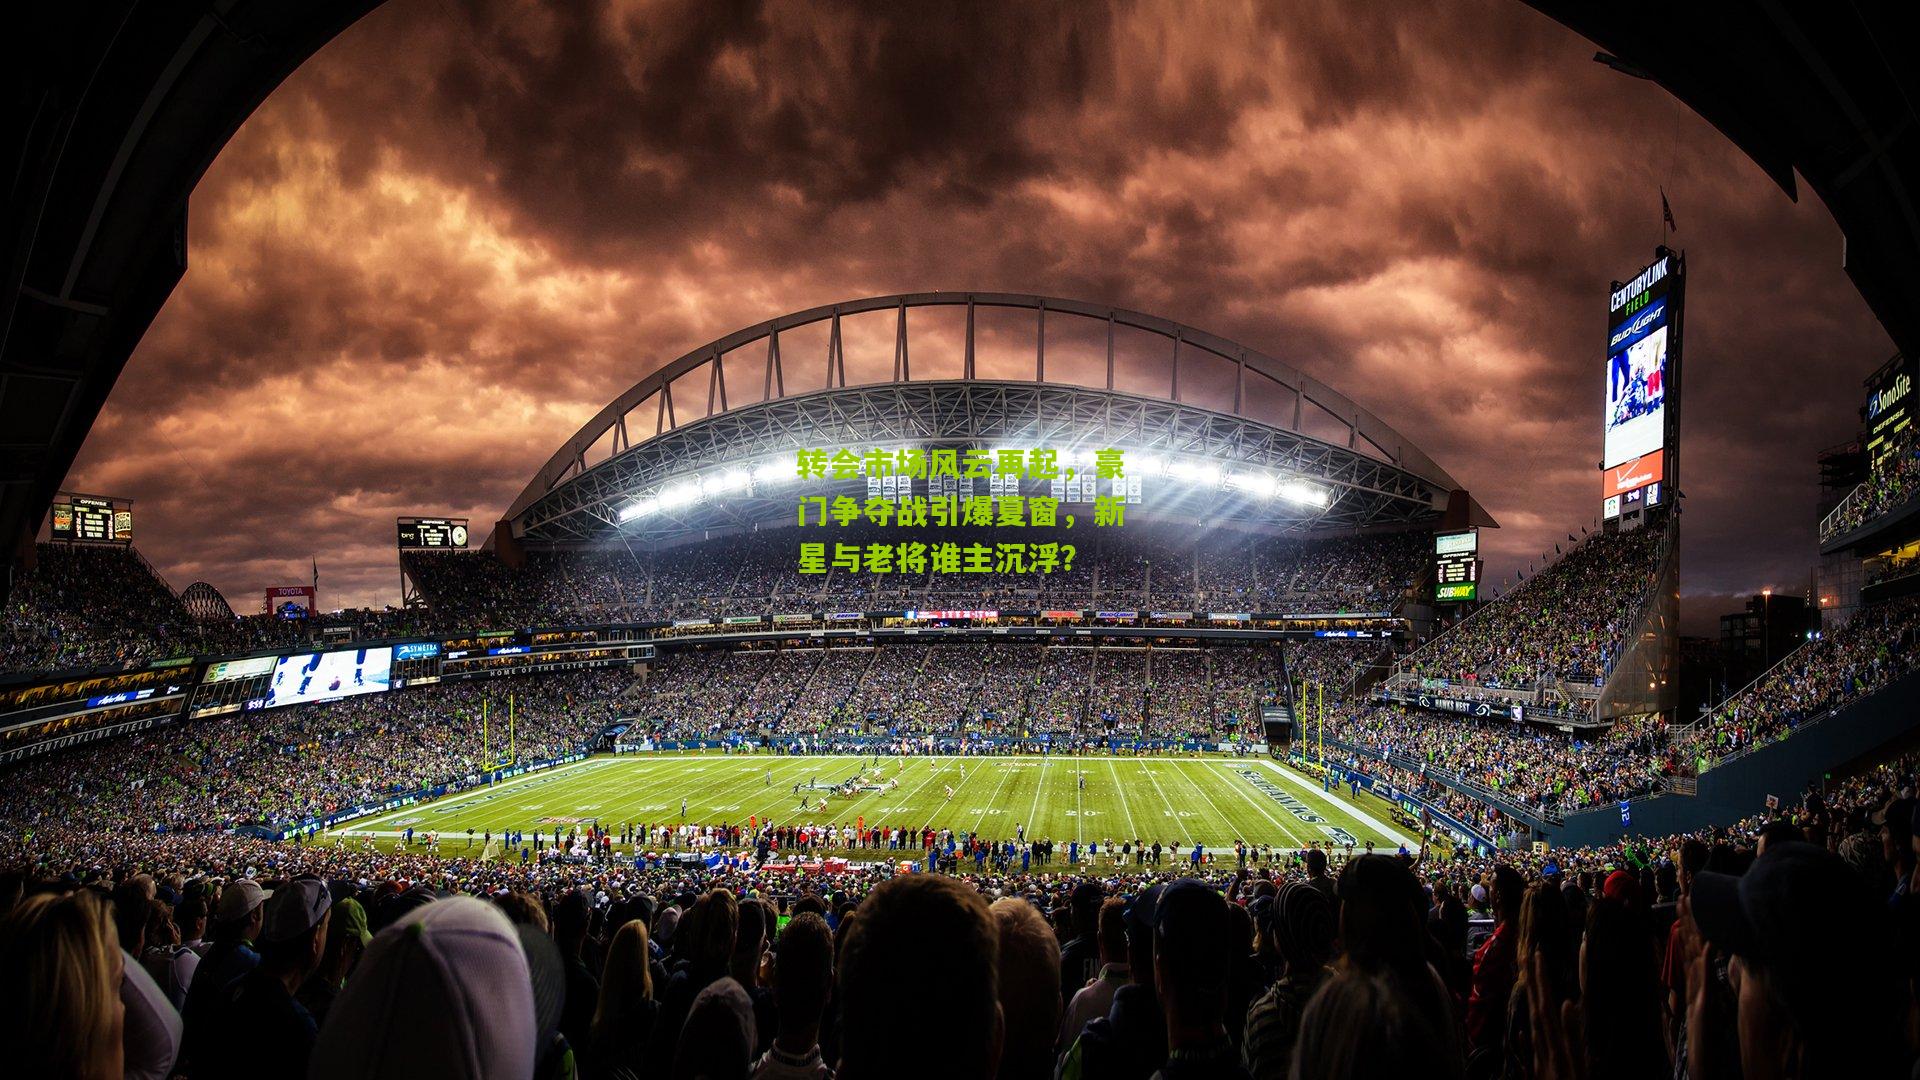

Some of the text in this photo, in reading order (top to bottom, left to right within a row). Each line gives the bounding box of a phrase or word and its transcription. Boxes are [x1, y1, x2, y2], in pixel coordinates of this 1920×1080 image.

[1611, 256, 1668, 313] CENTURYLINK
[1625, 290, 1650, 316] FIELD
[1610, 305, 1664, 347] BUD LIGHT
[1878, 373, 1911, 413] SonoSite
[278, 587, 303, 596] TOYOTA
[1437, 584, 1474, 599] SUBWAY
[490, 669, 516, 677] HOME
[521, 666, 532, 674] OF
[538, 664, 556, 672] THE
[589, 660, 609, 668] MAN
[9, 749, 24, 763] TO
[30, 728, 112, 757] CENTURYLINK
[117, 719, 154, 736] FIELD
[1233, 769, 1330, 824] SEAHAWKS
